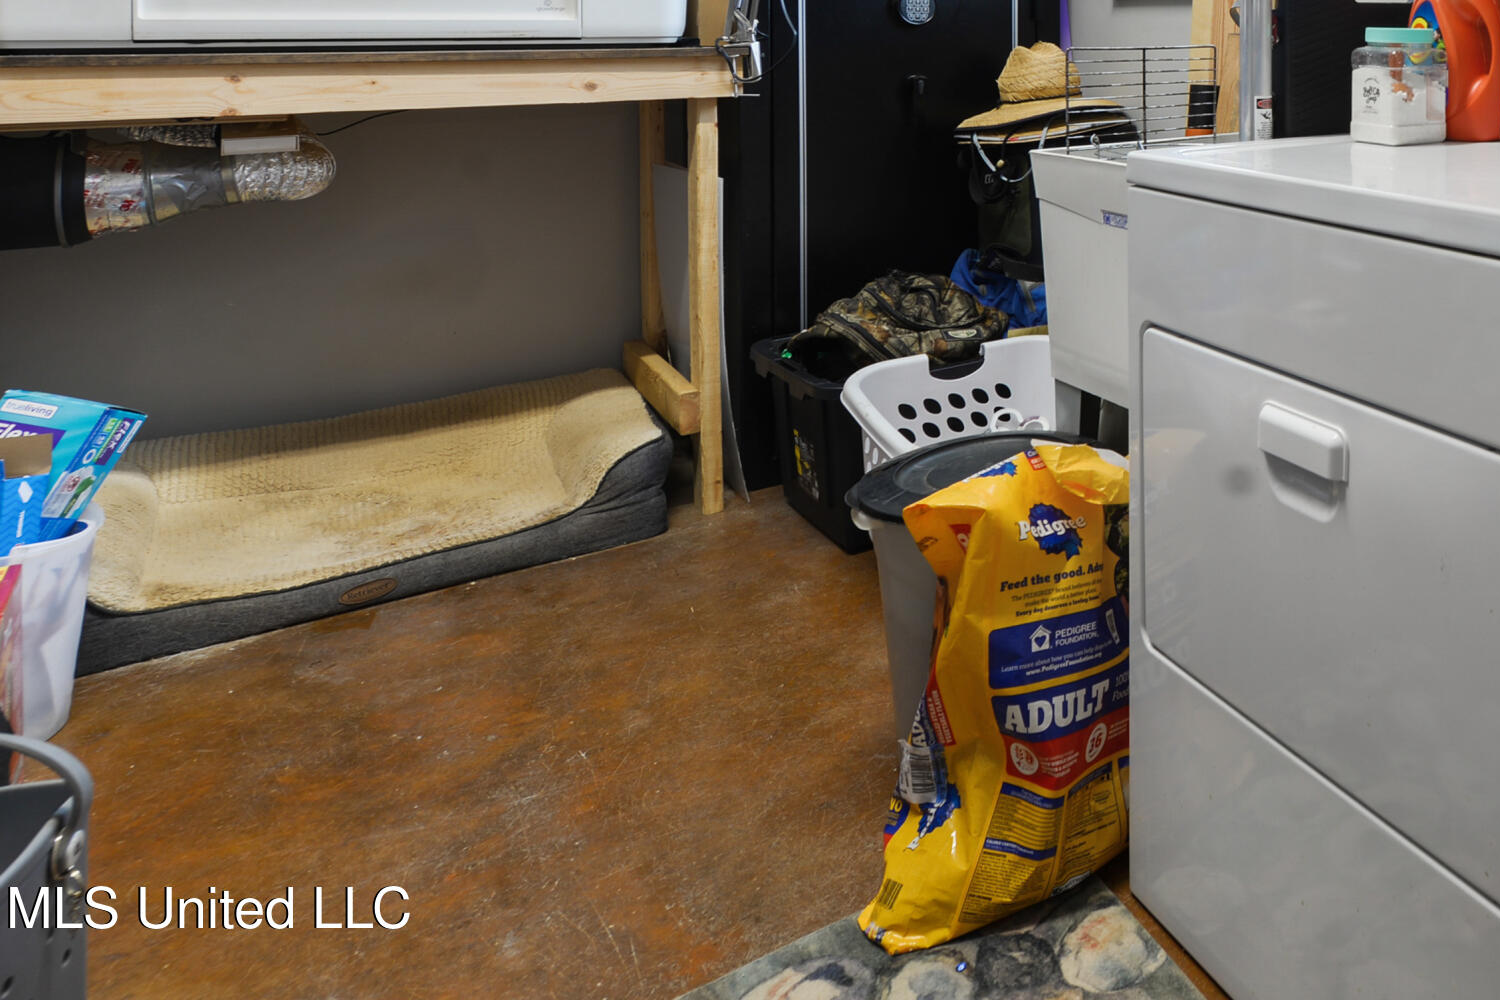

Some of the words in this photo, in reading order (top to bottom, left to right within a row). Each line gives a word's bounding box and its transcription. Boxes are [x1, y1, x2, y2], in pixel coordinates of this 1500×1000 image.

[1016, 516, 1087, 541] Pedigree
[1000, 576, 1028, 592] Feed
[1030, 573, 1051, 586] the
[1053, 565, 1086, 585] good.
[1016, 608, 1033, 617] Every
[1033, 606, 1044, 614] dog
[1055, 621, 1097, 639] PEDIGREE
[1001, 665, 1019, 673] Learn
[1019, 662, 1034, 670] more
[1035, 658, 1051, 668] about
[1051, 655, 1063, 664] how
[1005, 678, 1110, 734] ADULT
